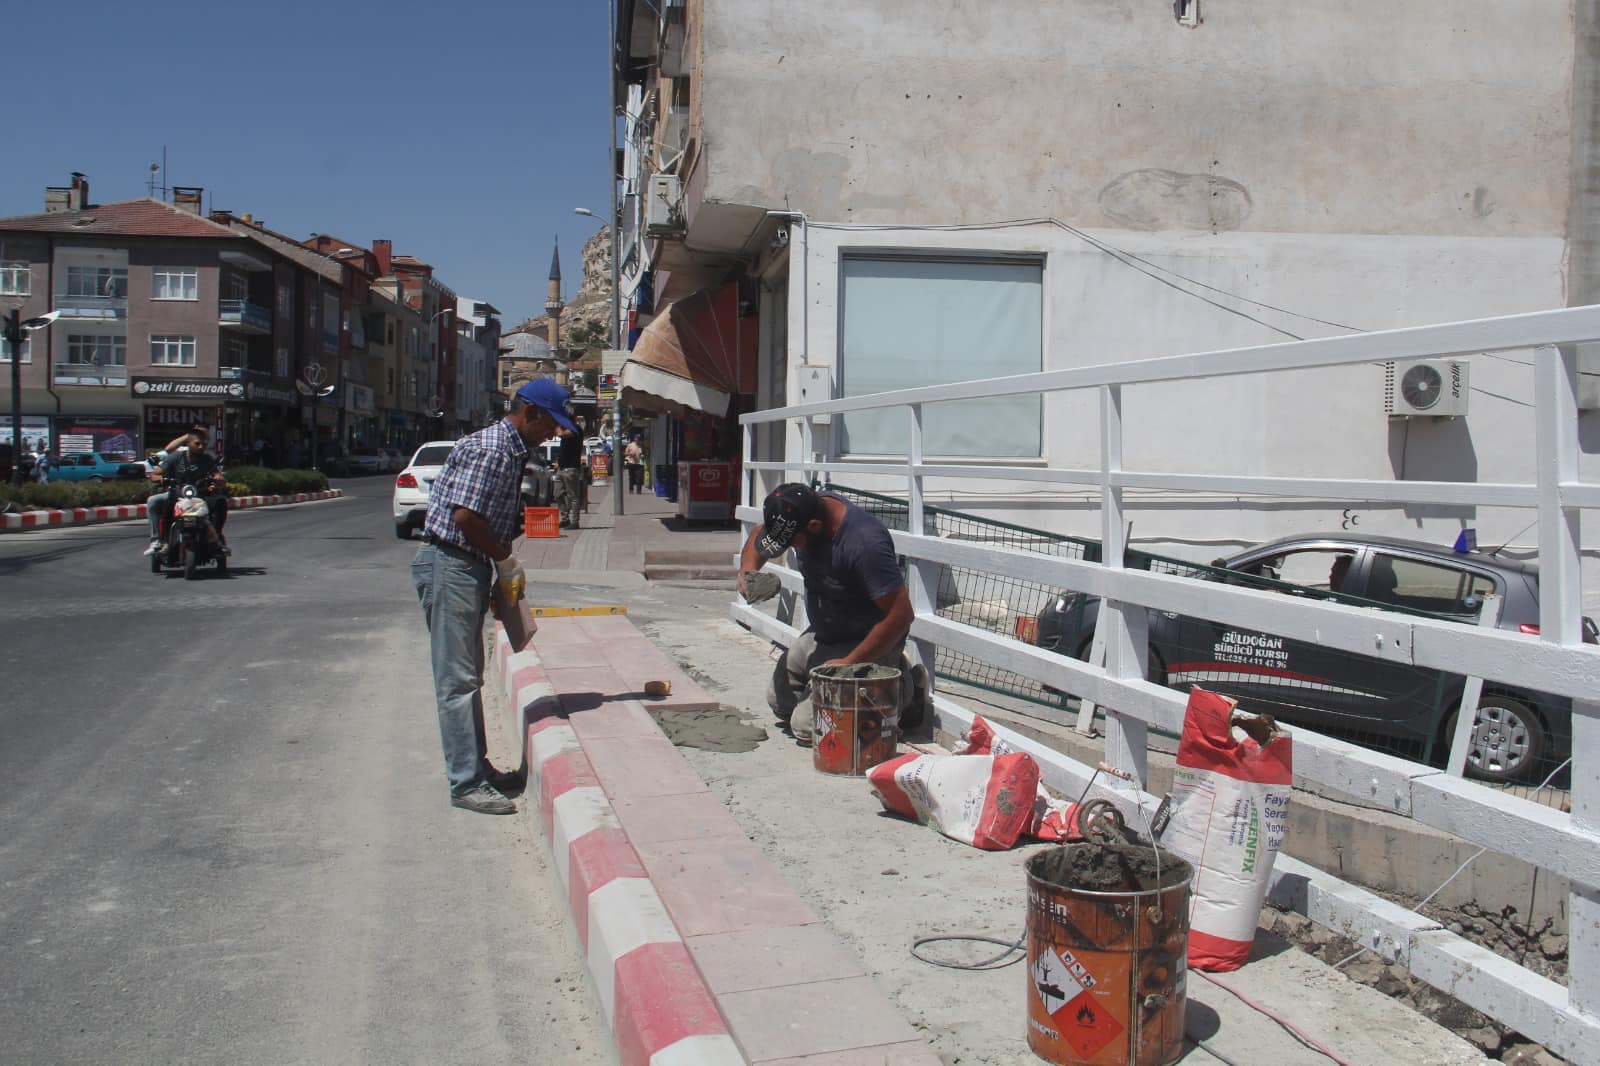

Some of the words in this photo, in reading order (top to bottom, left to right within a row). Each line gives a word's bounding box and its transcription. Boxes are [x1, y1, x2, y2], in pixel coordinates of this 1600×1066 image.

[150, 381, 173, 392] zeki
[174, 383, 228, 394] restaurant
[1448, 362, 1461, 398] arçelik
[147, 407, 204, 423] FIRIN
[764, 520, 798, 556] TRUCKS
[1222, 631, 1283, 649] GÜLDOĞAN
[1214, 642, 1254, 656] SÜRÜCÜ
[1255, 648, 1289, 660] KURSU
